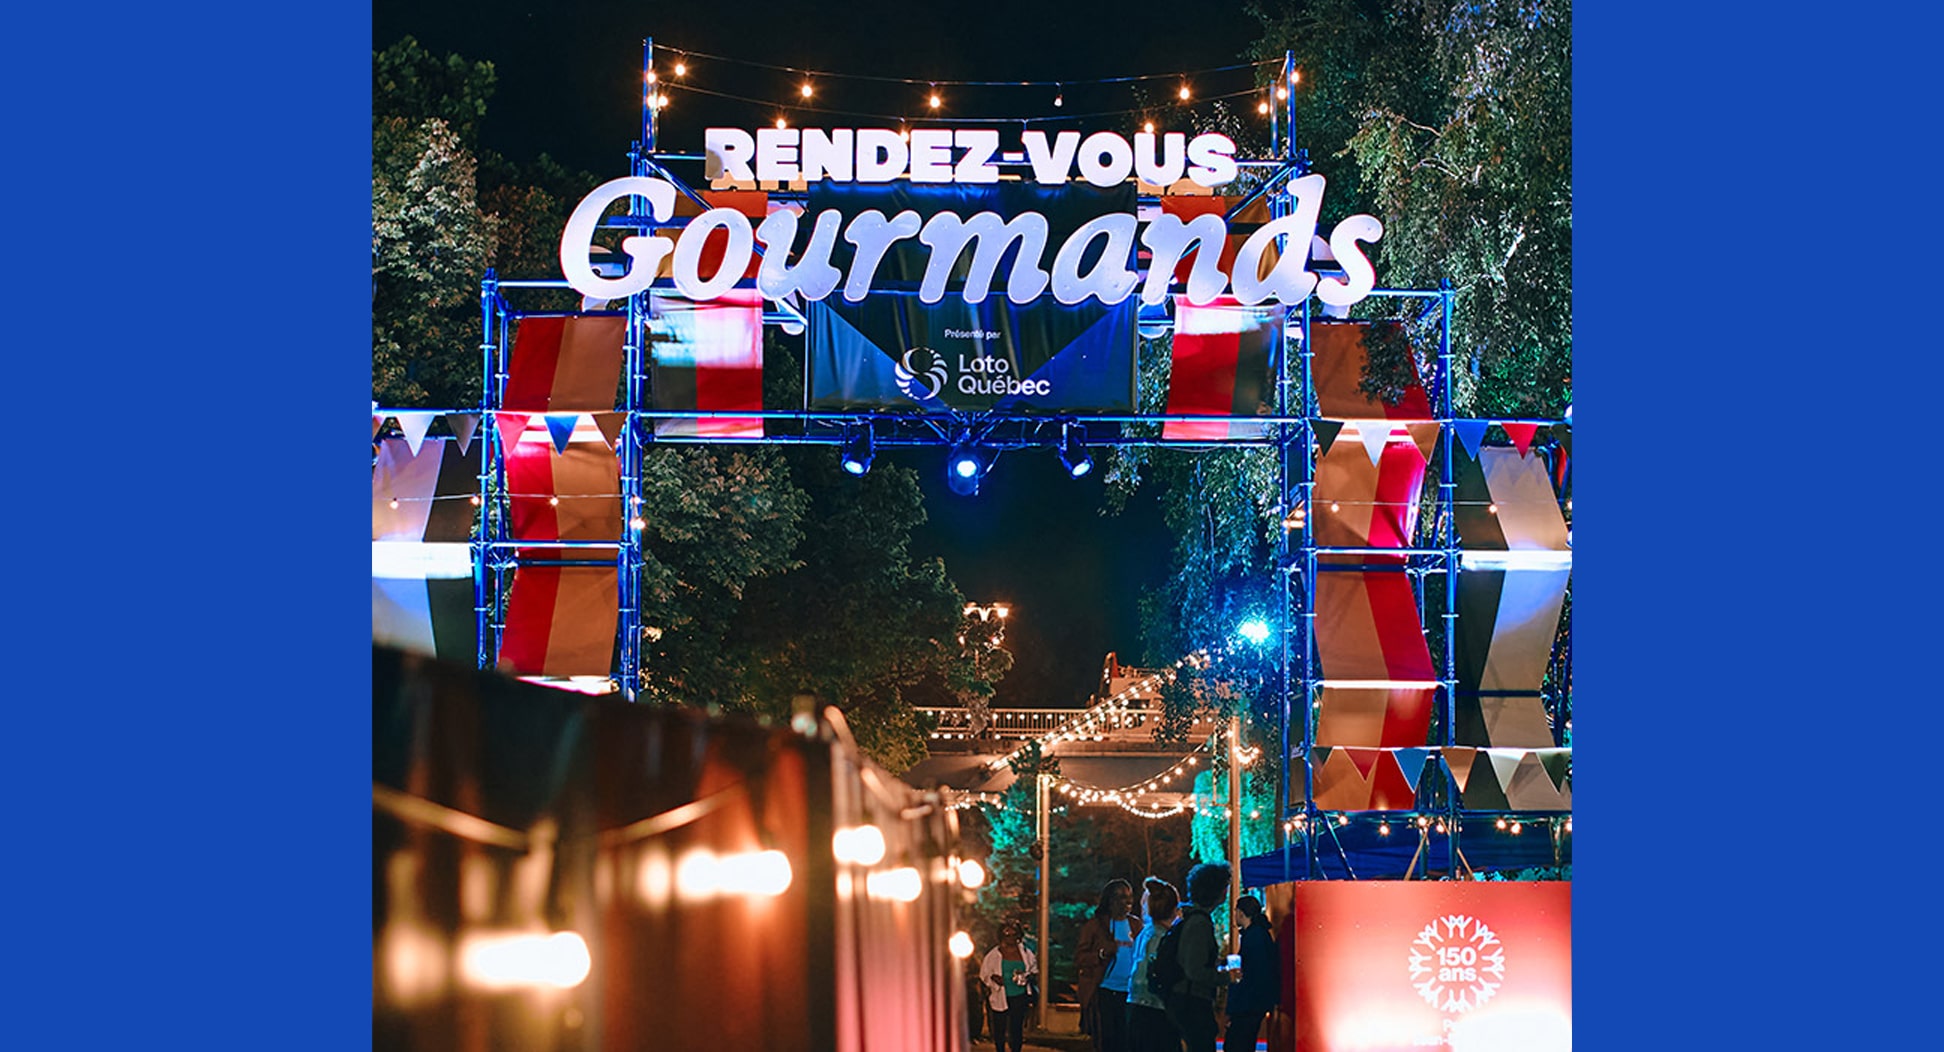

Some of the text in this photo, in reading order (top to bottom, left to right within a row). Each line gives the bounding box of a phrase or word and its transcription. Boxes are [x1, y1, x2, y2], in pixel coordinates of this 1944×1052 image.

[704, 127, 1237, 187] RENDEZ-VOUS
[560, 174, 1384, 307] Gourmands
[944, 328, 1001, 341] Présenté par
[958, 354, 1009, 374] Loto
[957, 375, 1051, 396] Québec
[1436, 946, 1477, 966] 150
[1438, 967, 1477, 982] ans
